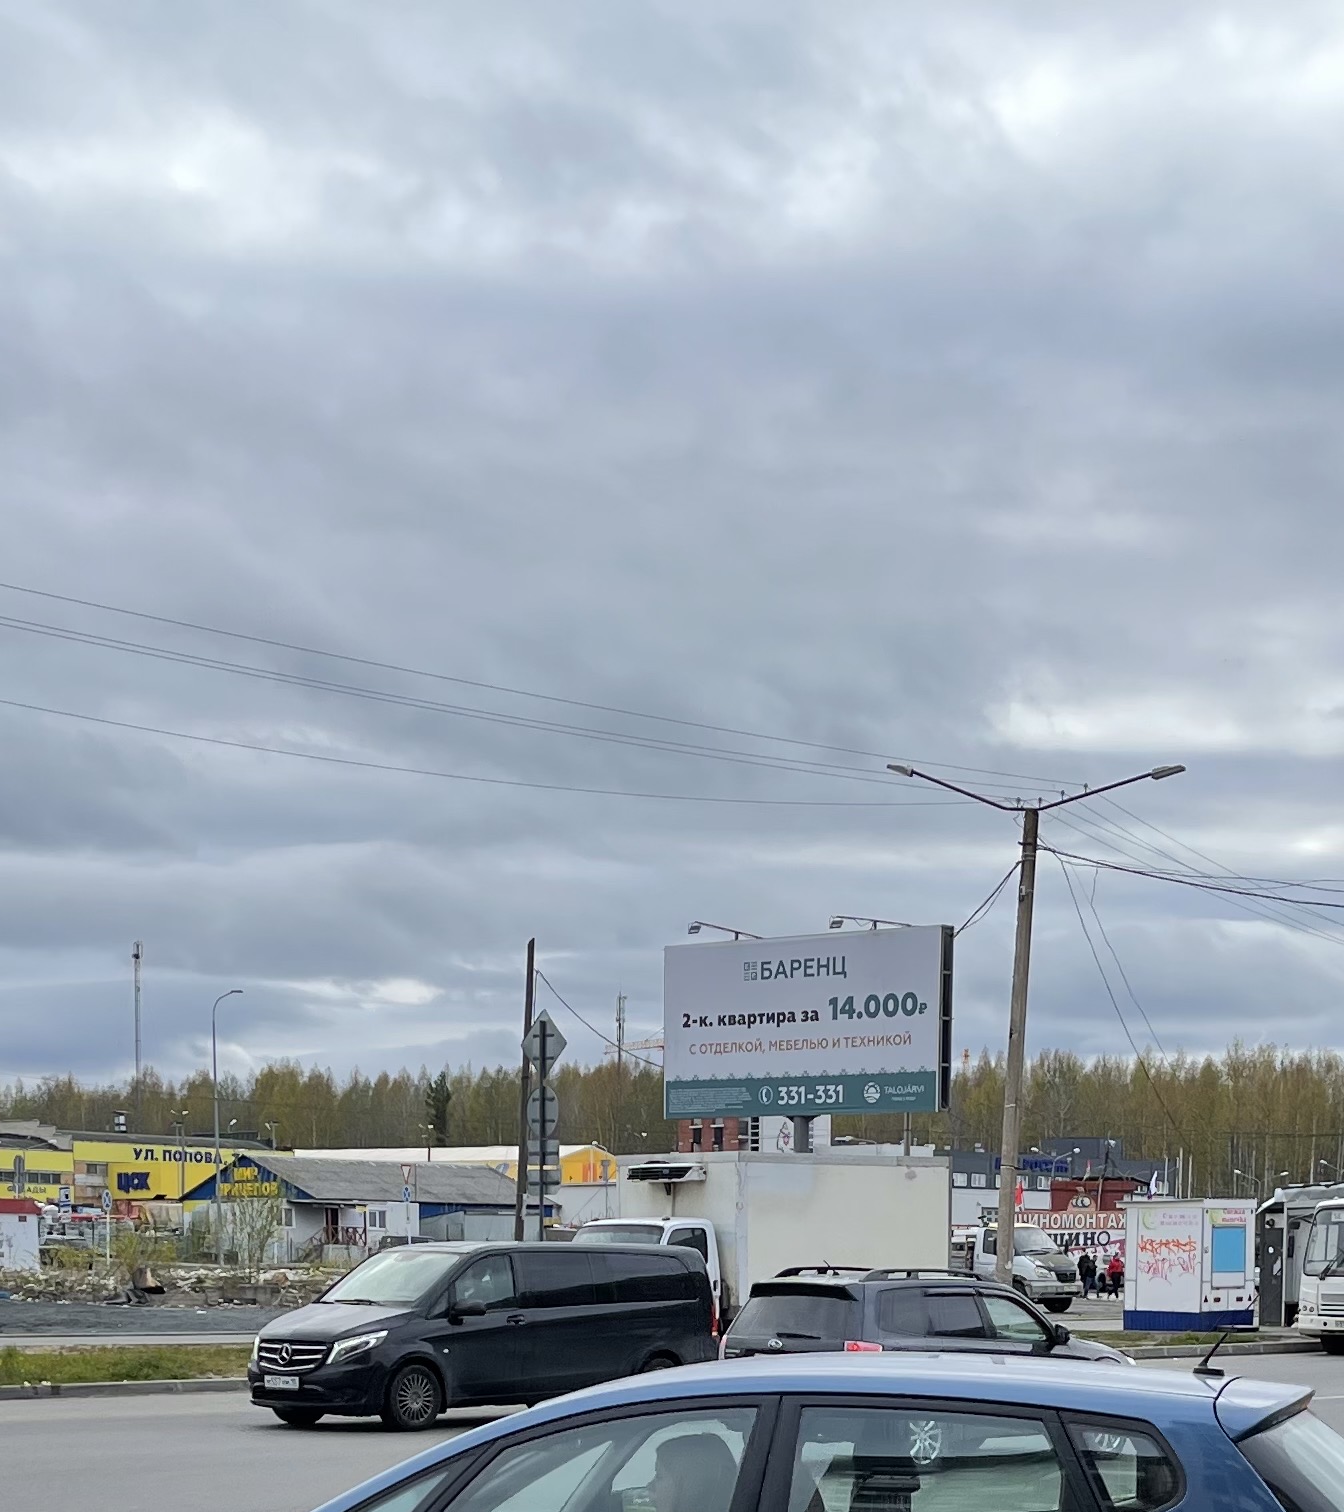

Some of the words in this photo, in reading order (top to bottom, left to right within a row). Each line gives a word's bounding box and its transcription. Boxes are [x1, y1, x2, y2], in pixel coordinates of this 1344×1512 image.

[760, 956, 847, 980] БАРЕНЦ
[682, 1013, 713, 1028] 2-к.
[717, 1011, 796, 1028] квартира
[800, 1009, 819, 1023] за
[689, 1044, 697, 1055] С
[699, 1038, 766, 1056] ОТДЕЛКОЙ,
[769, 1038, 829, 1052] МЕБЕЛЬЮ
[832, 1038, 841, 1049] И
[843, 1031, 912, 1048] ТЕХНИКОЙ
[777, 1084, 844, 1105] 331-331
[133, 1147, 158, 1161] УЛ.
